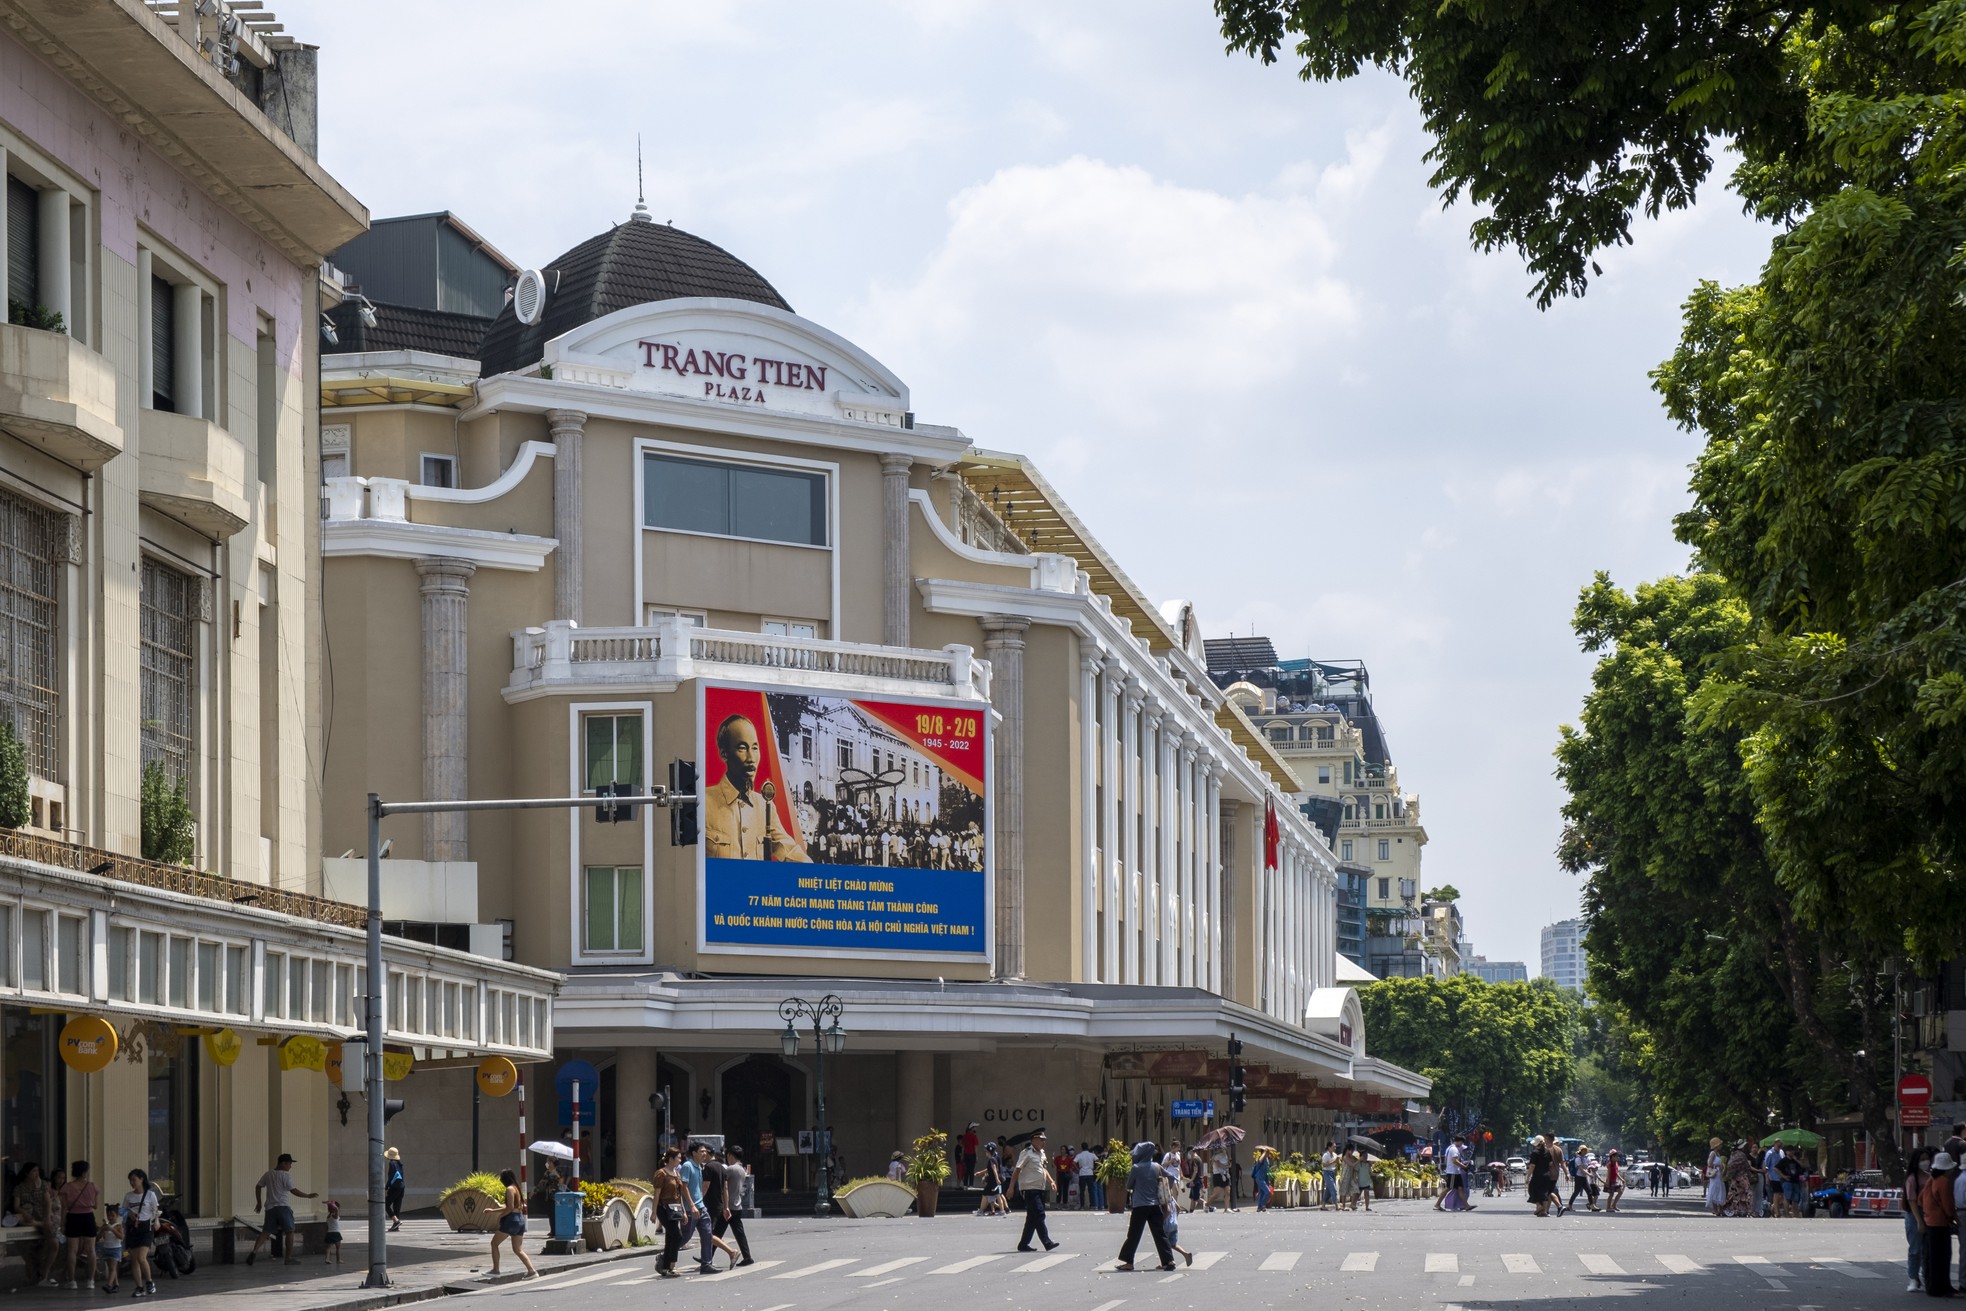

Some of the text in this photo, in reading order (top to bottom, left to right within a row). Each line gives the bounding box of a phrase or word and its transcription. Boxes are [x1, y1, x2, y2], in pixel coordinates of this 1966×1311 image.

[639, 340, 827, 391] TRANG TIEN
[705, 382, 766, 402] PLAZA
[916, 715, 943, 735] 19/8
[955, 718, 975, 737] 2/9
[923, 738, 942, 748] 1945
[950, 740, 969, 749] 2022
[798, 877, 823, 890] NHIỆT
[825, 878, 842, 891] LIỆT
[844, 879, 866, 891] CHÀO
[749, 896, 759, 905] 77
[784, 896, 807, 908] CÁCH
[809, 899, 834, 910] MẠNG
[837, 899, 864, 910] THÁNG
[867, 900, 884, 911] TÁM
[887, 901, 914, 912] THÀNH
[916, 902, 938, 914] CÔNG
[714, 913, 725, 925] VÀ
[728, 913, 750, 926] QUỐC
[810, 918, 833, 931] CỘNG
[869, 920, 882, 933] HỘI
[931, 923, 948, 935] VIỆT
[950, 925, 969, 935] NAM
[78, 1047, 97, 1055] Bank
[984, 1108, 1045, 1121] GUCCI
